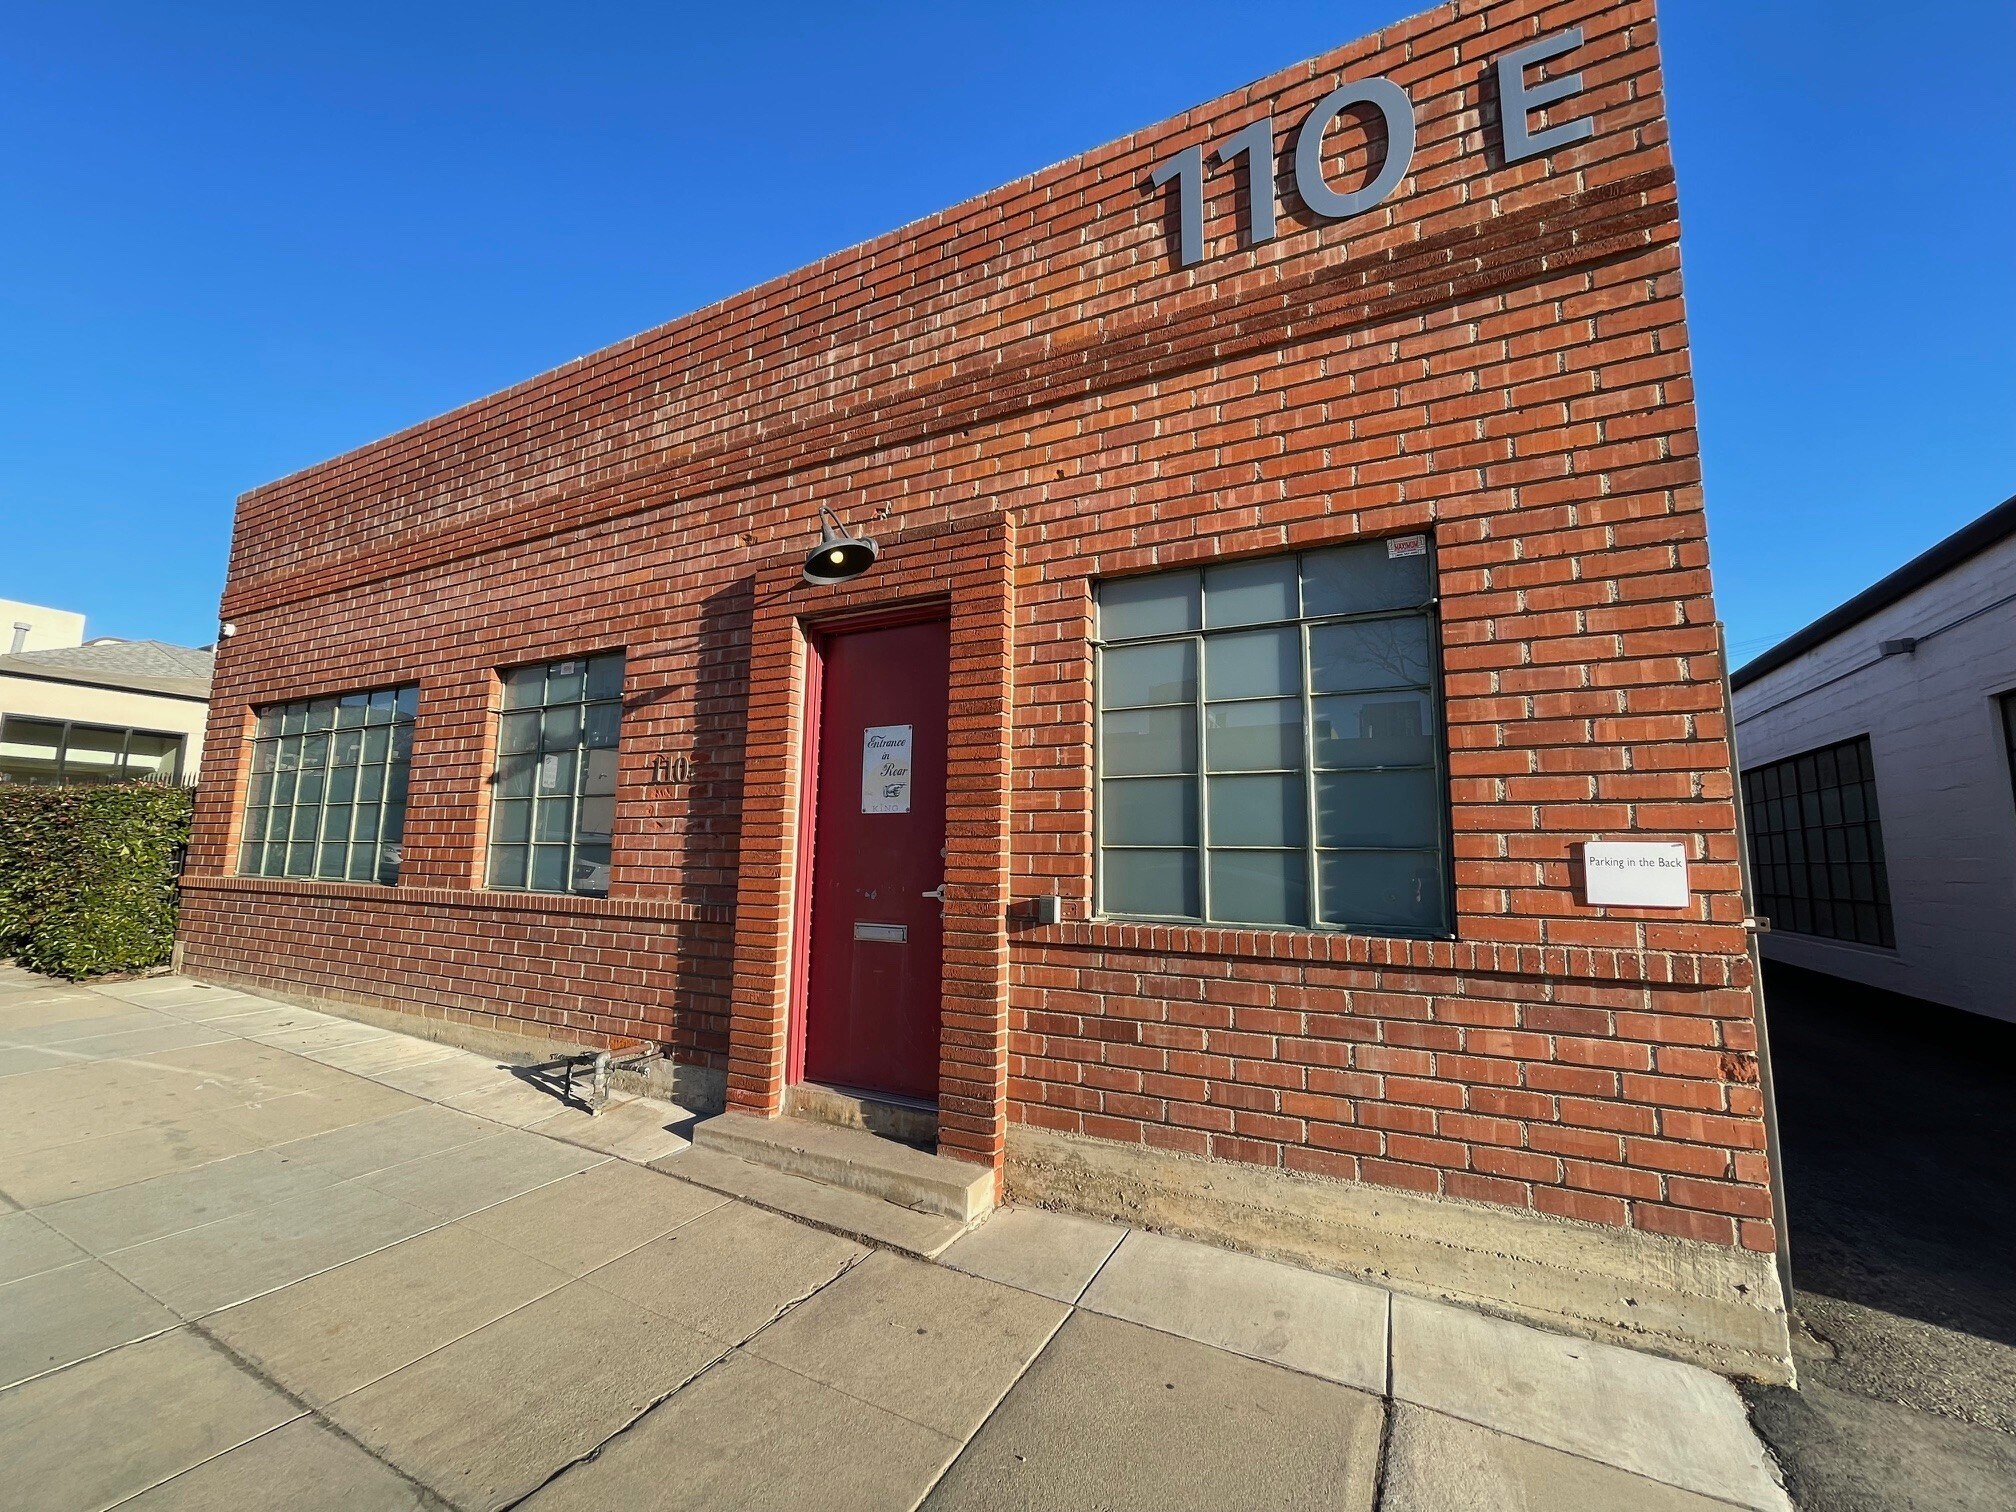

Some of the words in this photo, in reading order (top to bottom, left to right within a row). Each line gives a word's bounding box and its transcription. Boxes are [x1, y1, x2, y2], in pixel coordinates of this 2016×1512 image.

[1150, 77, 1415, 267] 110
[1497, 27, 1594, 163] E
[868, 735, 906, 748] Entrance
[881, 752, 889, 760] in
[880, 763, 908, 777] Rear
[1589, 856, 1624, 869] Parking
[1627, 858, 1636, 867] in
[1639, 858, 1655, 867] the
[1658, 857, 1682, 868] Back
